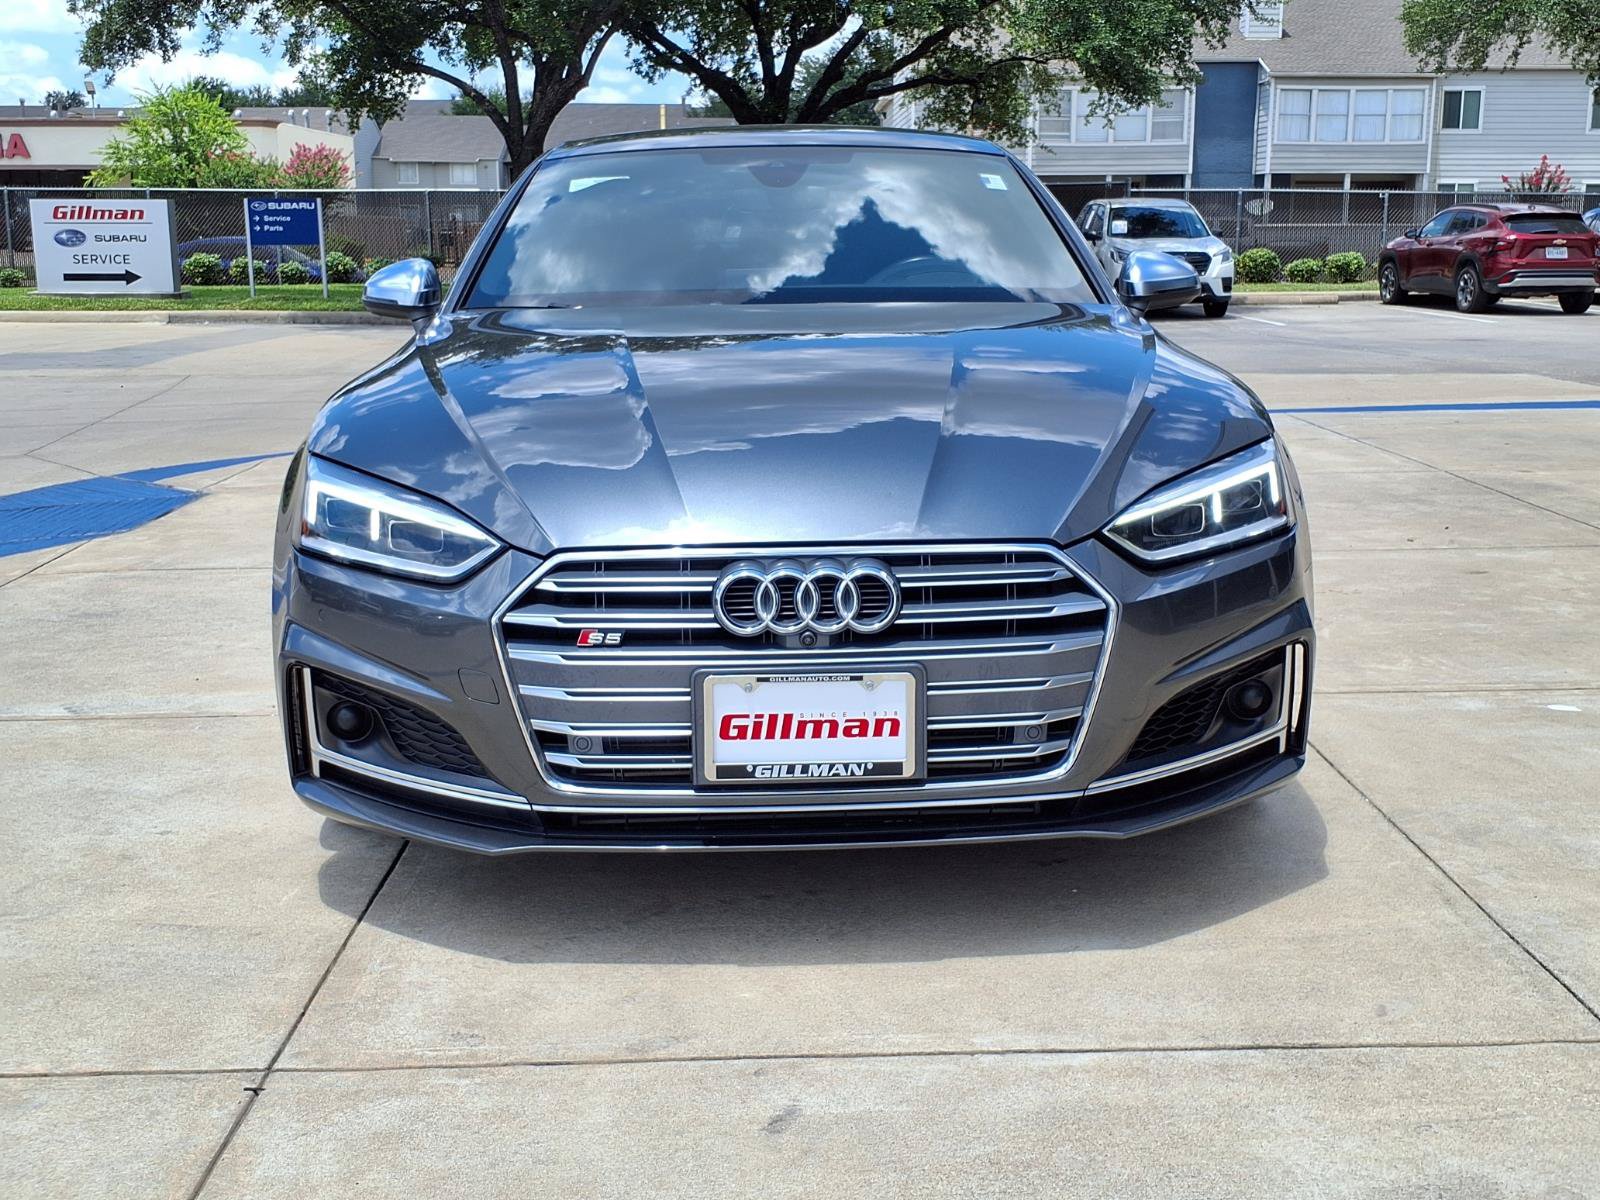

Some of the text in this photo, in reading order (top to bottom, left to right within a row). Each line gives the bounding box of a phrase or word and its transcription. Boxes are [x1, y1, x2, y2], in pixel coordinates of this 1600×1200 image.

[0, 133, 31, 159] A
[52, 205, 145, 220] Gillman
[267, 202, 315, 210] SUBARU
[94, 234, 147, 243] SUBARU
[72, 254, 131, 264] SERVICE
[585, 632, 622, 645] S5
[719, 713, 901, 740] Gillman
[754, 763, 865, 778] GILLMAN
